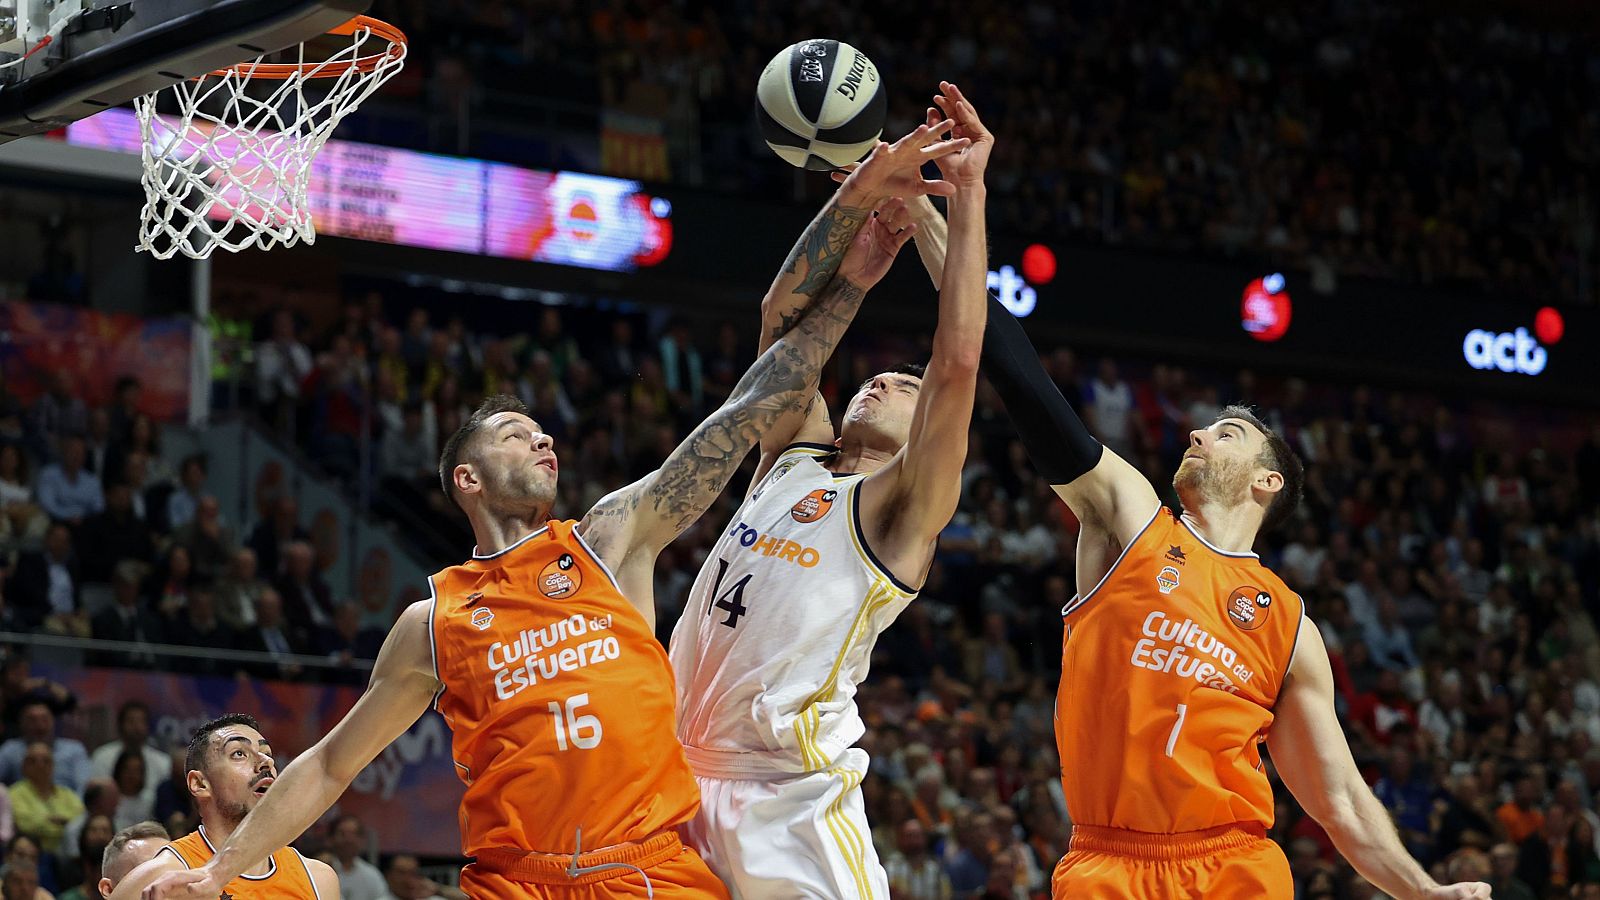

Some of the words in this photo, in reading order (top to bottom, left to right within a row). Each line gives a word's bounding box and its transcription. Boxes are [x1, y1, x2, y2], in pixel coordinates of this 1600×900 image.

[708, 558, 753, 629] 14
[1235, 598, 1255, 613] Copa
[488, 614, 587, 671] Cultura
[589, 614, 612, 631] del
[494, 636, 620, 700] Esfuerzo
[1142, 611, 1238, 669] Cultura
[1233, 664, 1253, 683] del
[548, 693, 603, 751] 16
[1165, 704, 1187, 758] 1
